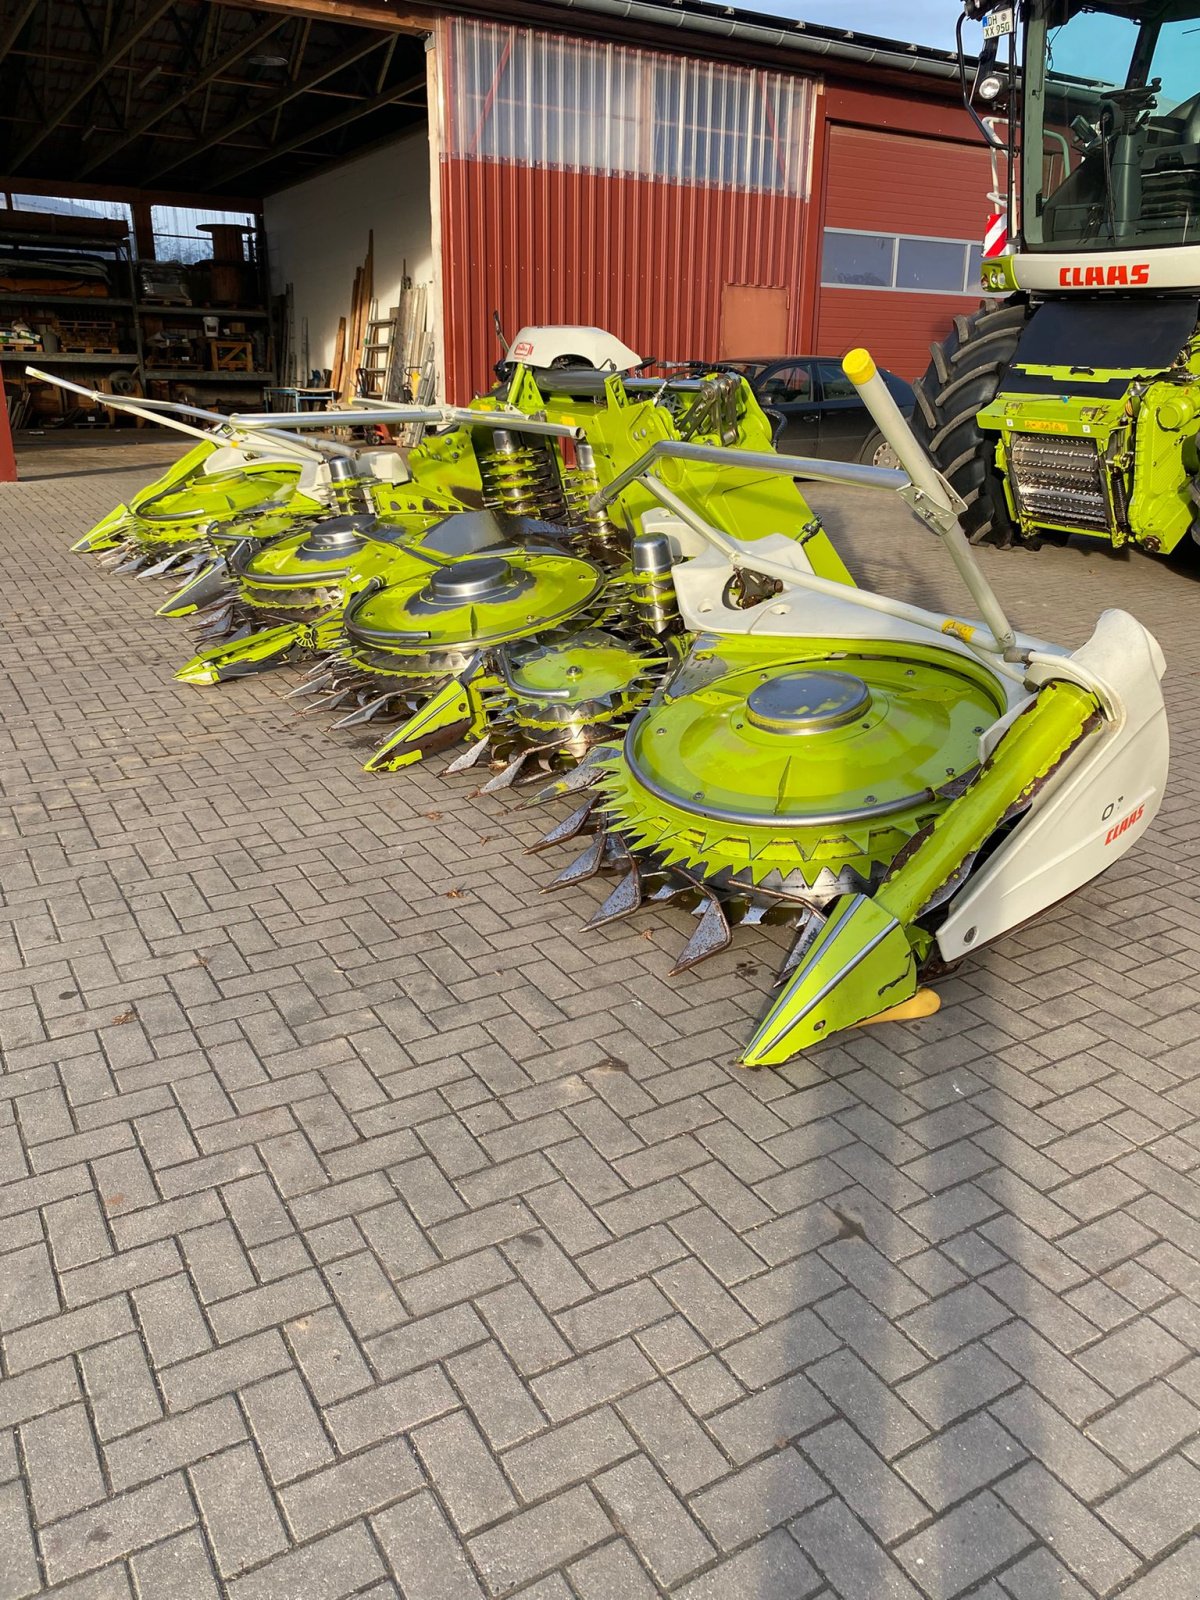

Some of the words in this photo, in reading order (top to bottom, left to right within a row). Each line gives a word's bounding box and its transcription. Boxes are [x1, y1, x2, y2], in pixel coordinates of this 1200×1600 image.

[985, 26, 995, 37] XX
[996, 22, 1010, 34] 950
[987, 15, 998, 27] DH
[1059, 264, 1150, 286] CLAAS
[1104, 803, 1145, 846] CLAAS
